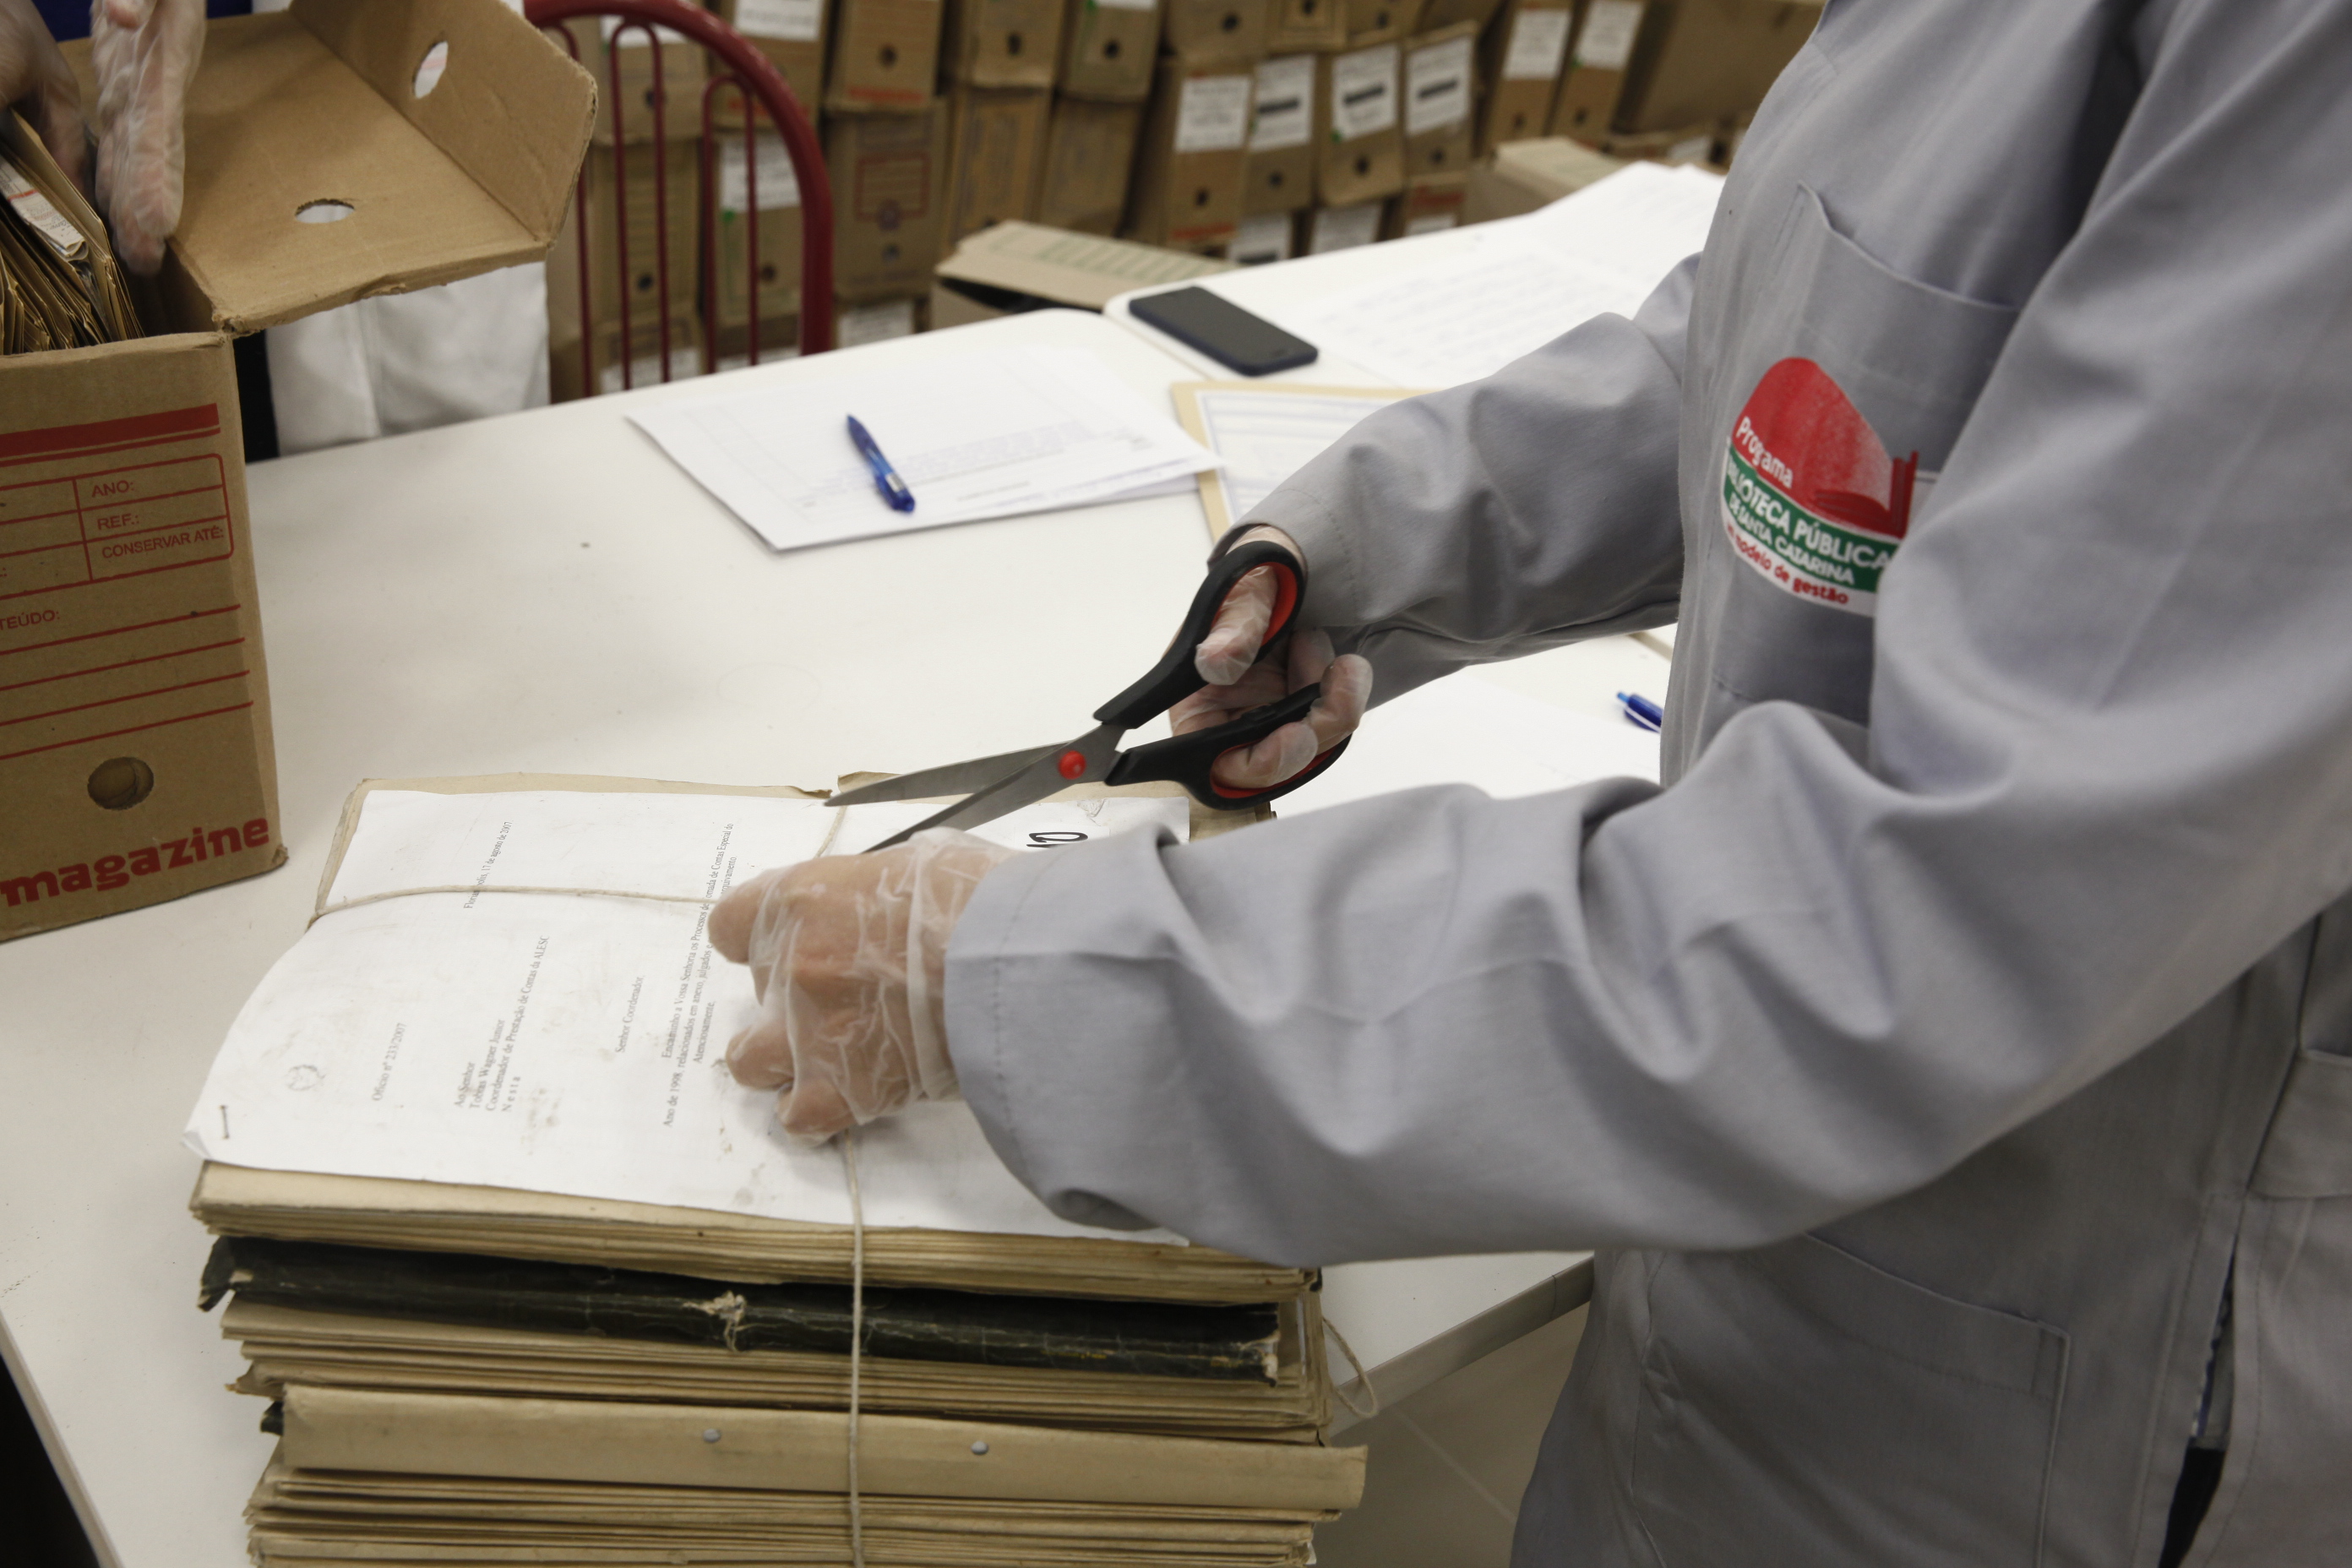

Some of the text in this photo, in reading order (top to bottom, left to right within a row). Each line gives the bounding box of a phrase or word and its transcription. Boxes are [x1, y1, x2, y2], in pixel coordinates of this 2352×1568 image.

[1735, 416, 1793, 488] Progama
[91, 480, 134, 498] ANO:
[97, 513, 139, 531] REF.:
[101, 524, 224, 558] CONSERVAR ATÉ:
[1793, 518, 1890, 570] PÚBLICA
[1775, 536, 1855, 585] CATARINA
[1775, 564, 1789, 582] de
[1792, 577, 1848, 604] gestão
[716, 830, 732, 851] Especial
[0, 817, 270, 907] magazine
[463, 872, 489, 908] Floriaolis,
[490, 841, 504, 858] agosto
[710, 851, 724, 870] Contas
[721, 856, 738, 895] rquivamento.
[705, 879, 716, 900] omada
[690, 911, 707, 942] Processos
[691, 942, 699, 950] os
[680, 951, 696, 982] Senhoria
[696, 950, 711, 979] julgados
[673, 983, 689, 1004] Vossa
[486, 934, 549, 1111] Coordenador de Prestação de Contas da ALESC
[689, 1004, 698, 1016] em
[385, 1021, 406, 1060] 233/2007
[614, 1025, 630, 1054] Senhor
[661, 1013, 681, 1059] Encaminho
[677, 1017, 695, 1068] relacionados
[454, 1062, 475, 1108] Ao Senhor
[667, 1095, 678, 1106] de
[663, 1108, 675, 1128] Ano
